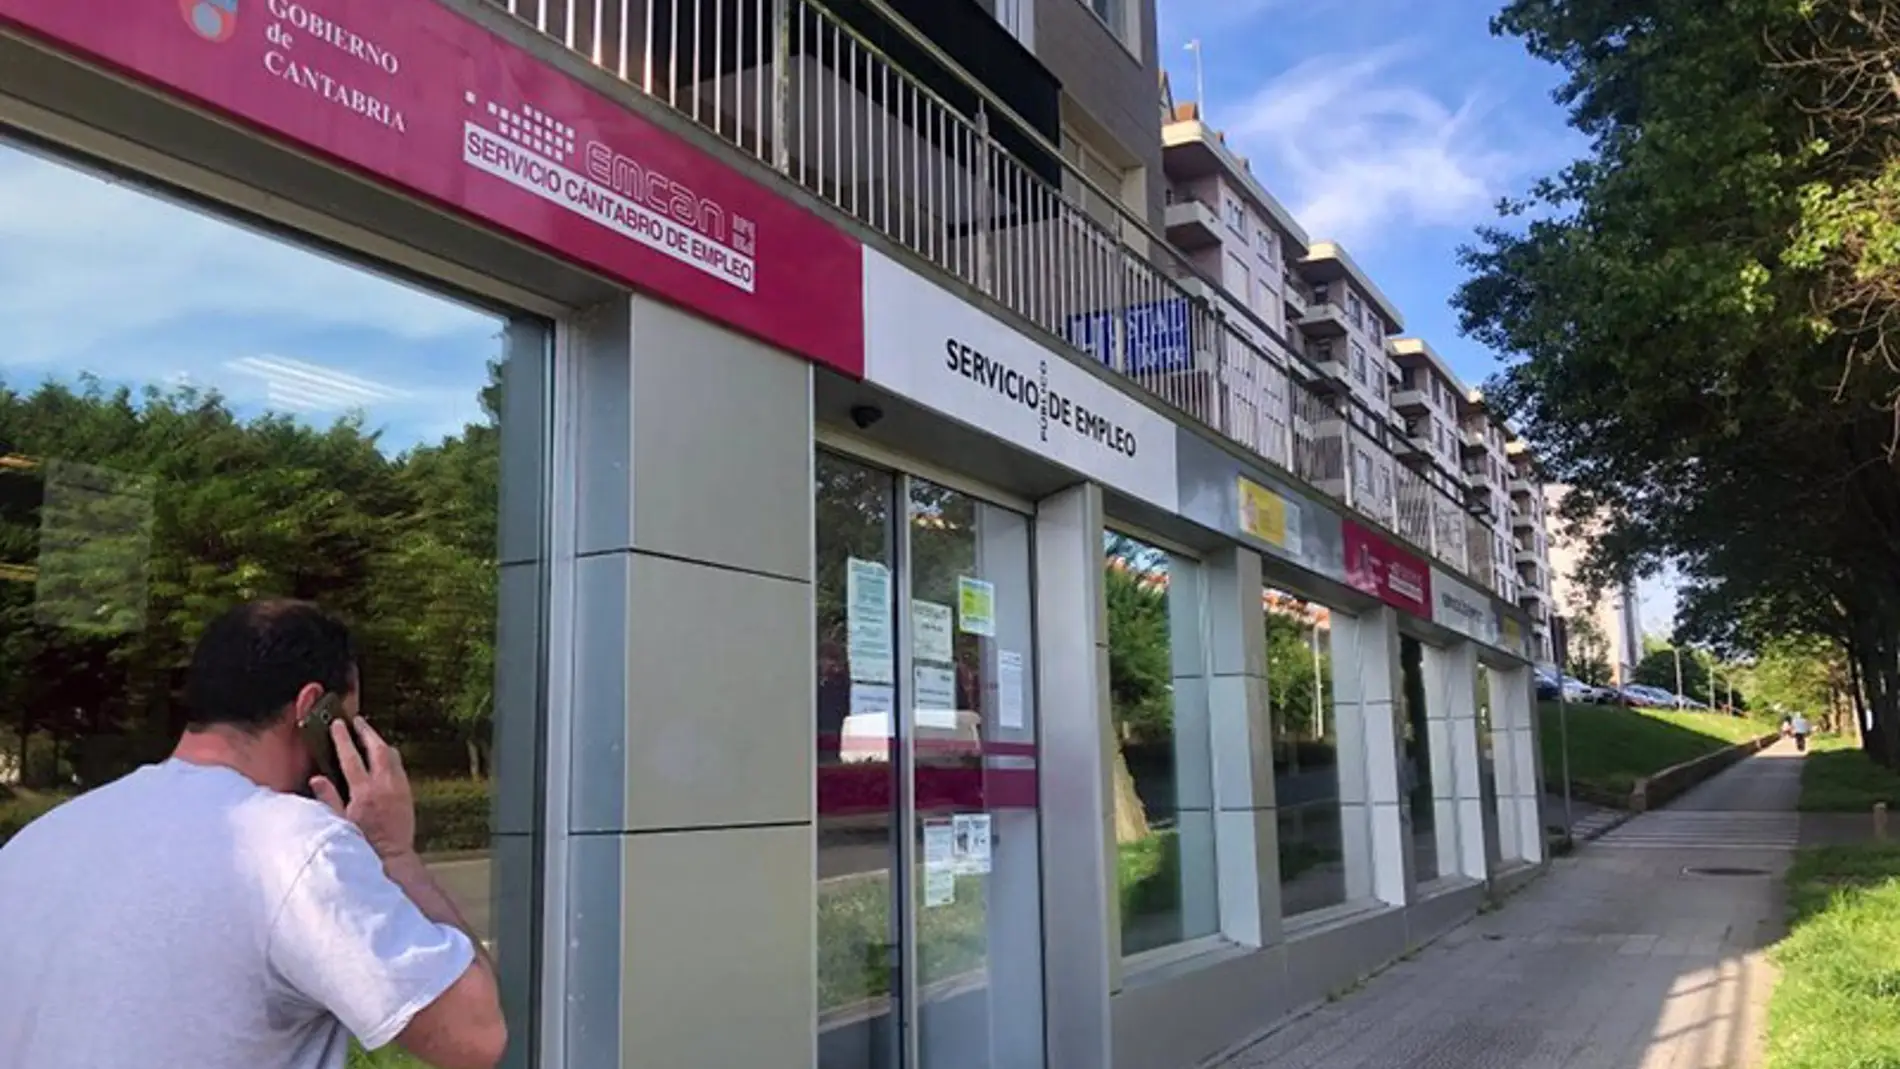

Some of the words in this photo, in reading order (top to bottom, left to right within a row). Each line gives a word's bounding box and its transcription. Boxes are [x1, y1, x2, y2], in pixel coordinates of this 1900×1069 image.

[266, 23, 293, 50] de
[267, 0, 399, 74] GOBIERNO
[264, 51, 405, 133] CANTABRIA
[467, 131, 561, 193] SERVICIO
[565, 180, 663, 241] CÁNTABRO
[666, 227, 689, 254] DE
[691, 239, 752, 283] EMPLEO
[946, 338, 1039, 409] SERVICIO
[1049, 391, 1072, 427] DE
[1076, 405, 1137, 457] EMPLEO
